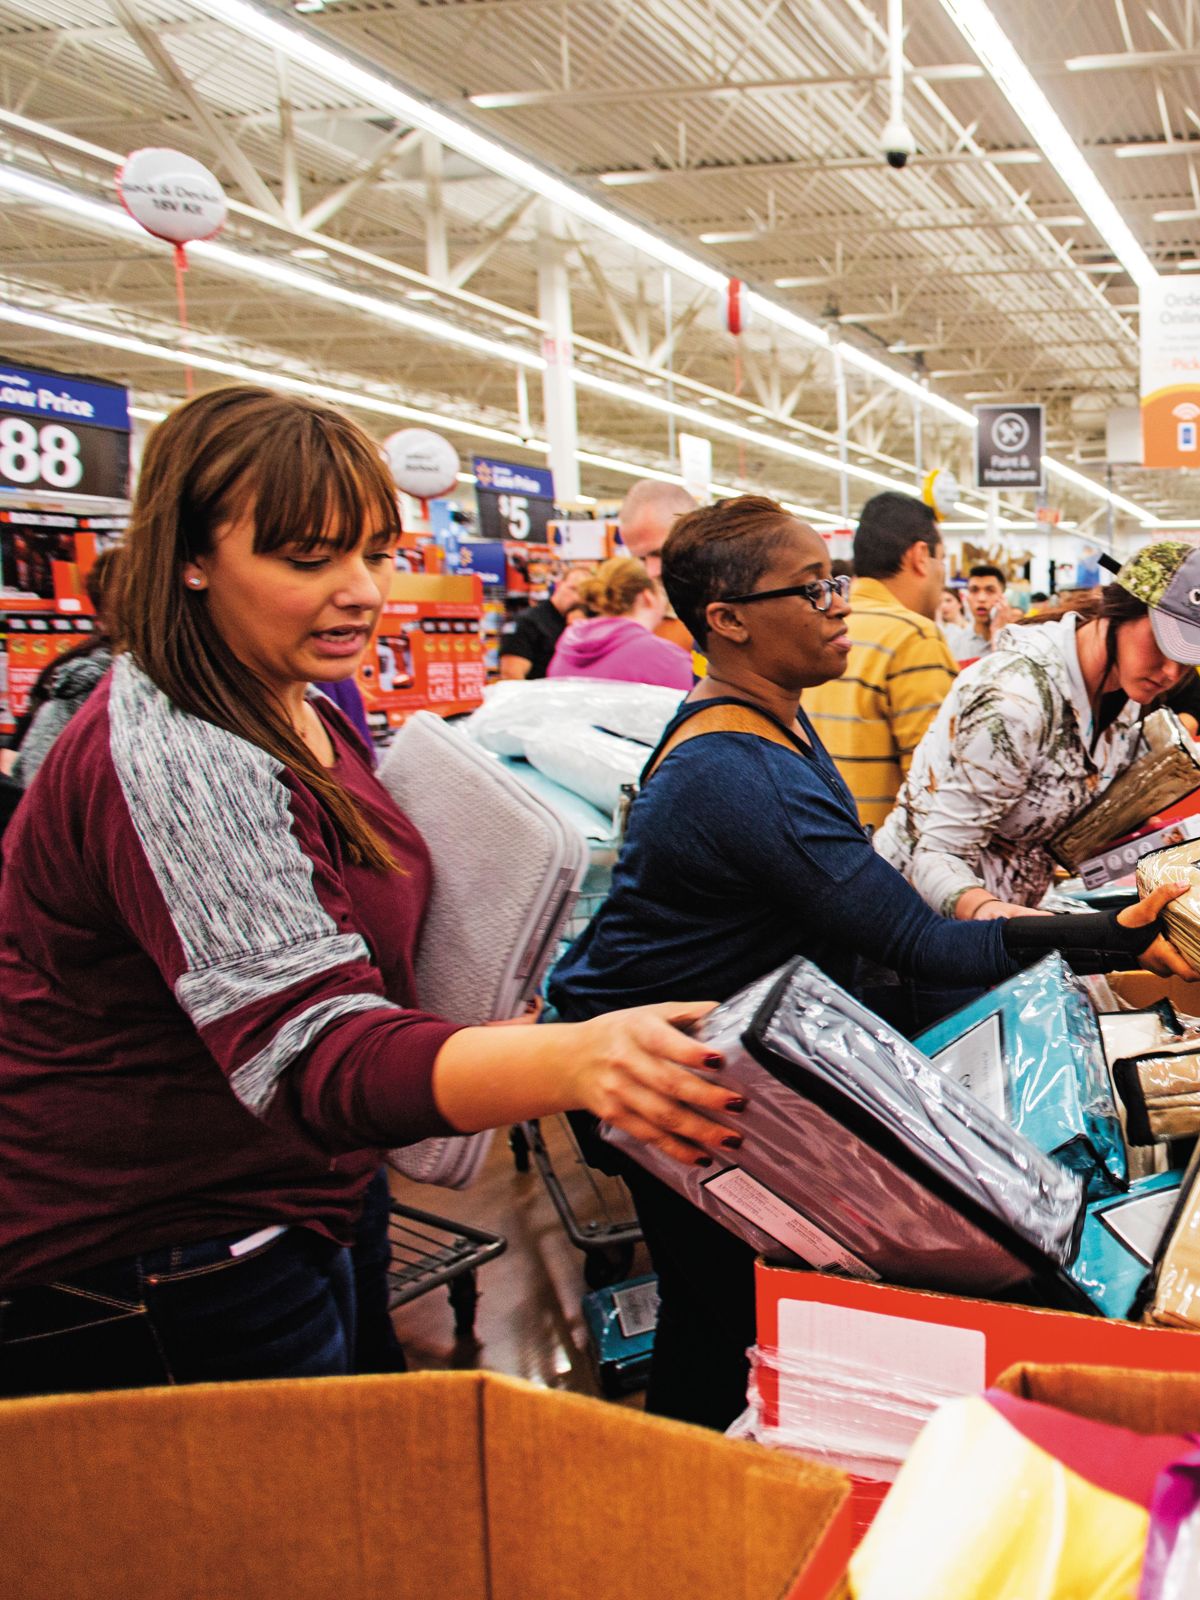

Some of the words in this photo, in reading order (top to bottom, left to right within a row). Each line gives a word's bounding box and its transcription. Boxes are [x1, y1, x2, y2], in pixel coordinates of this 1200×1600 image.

[0, 387, 37, 408] ow
[38, 388, 95, 418] Price
[0, 417, 83, 488] 88
[498, 495, 531, 539] $5
